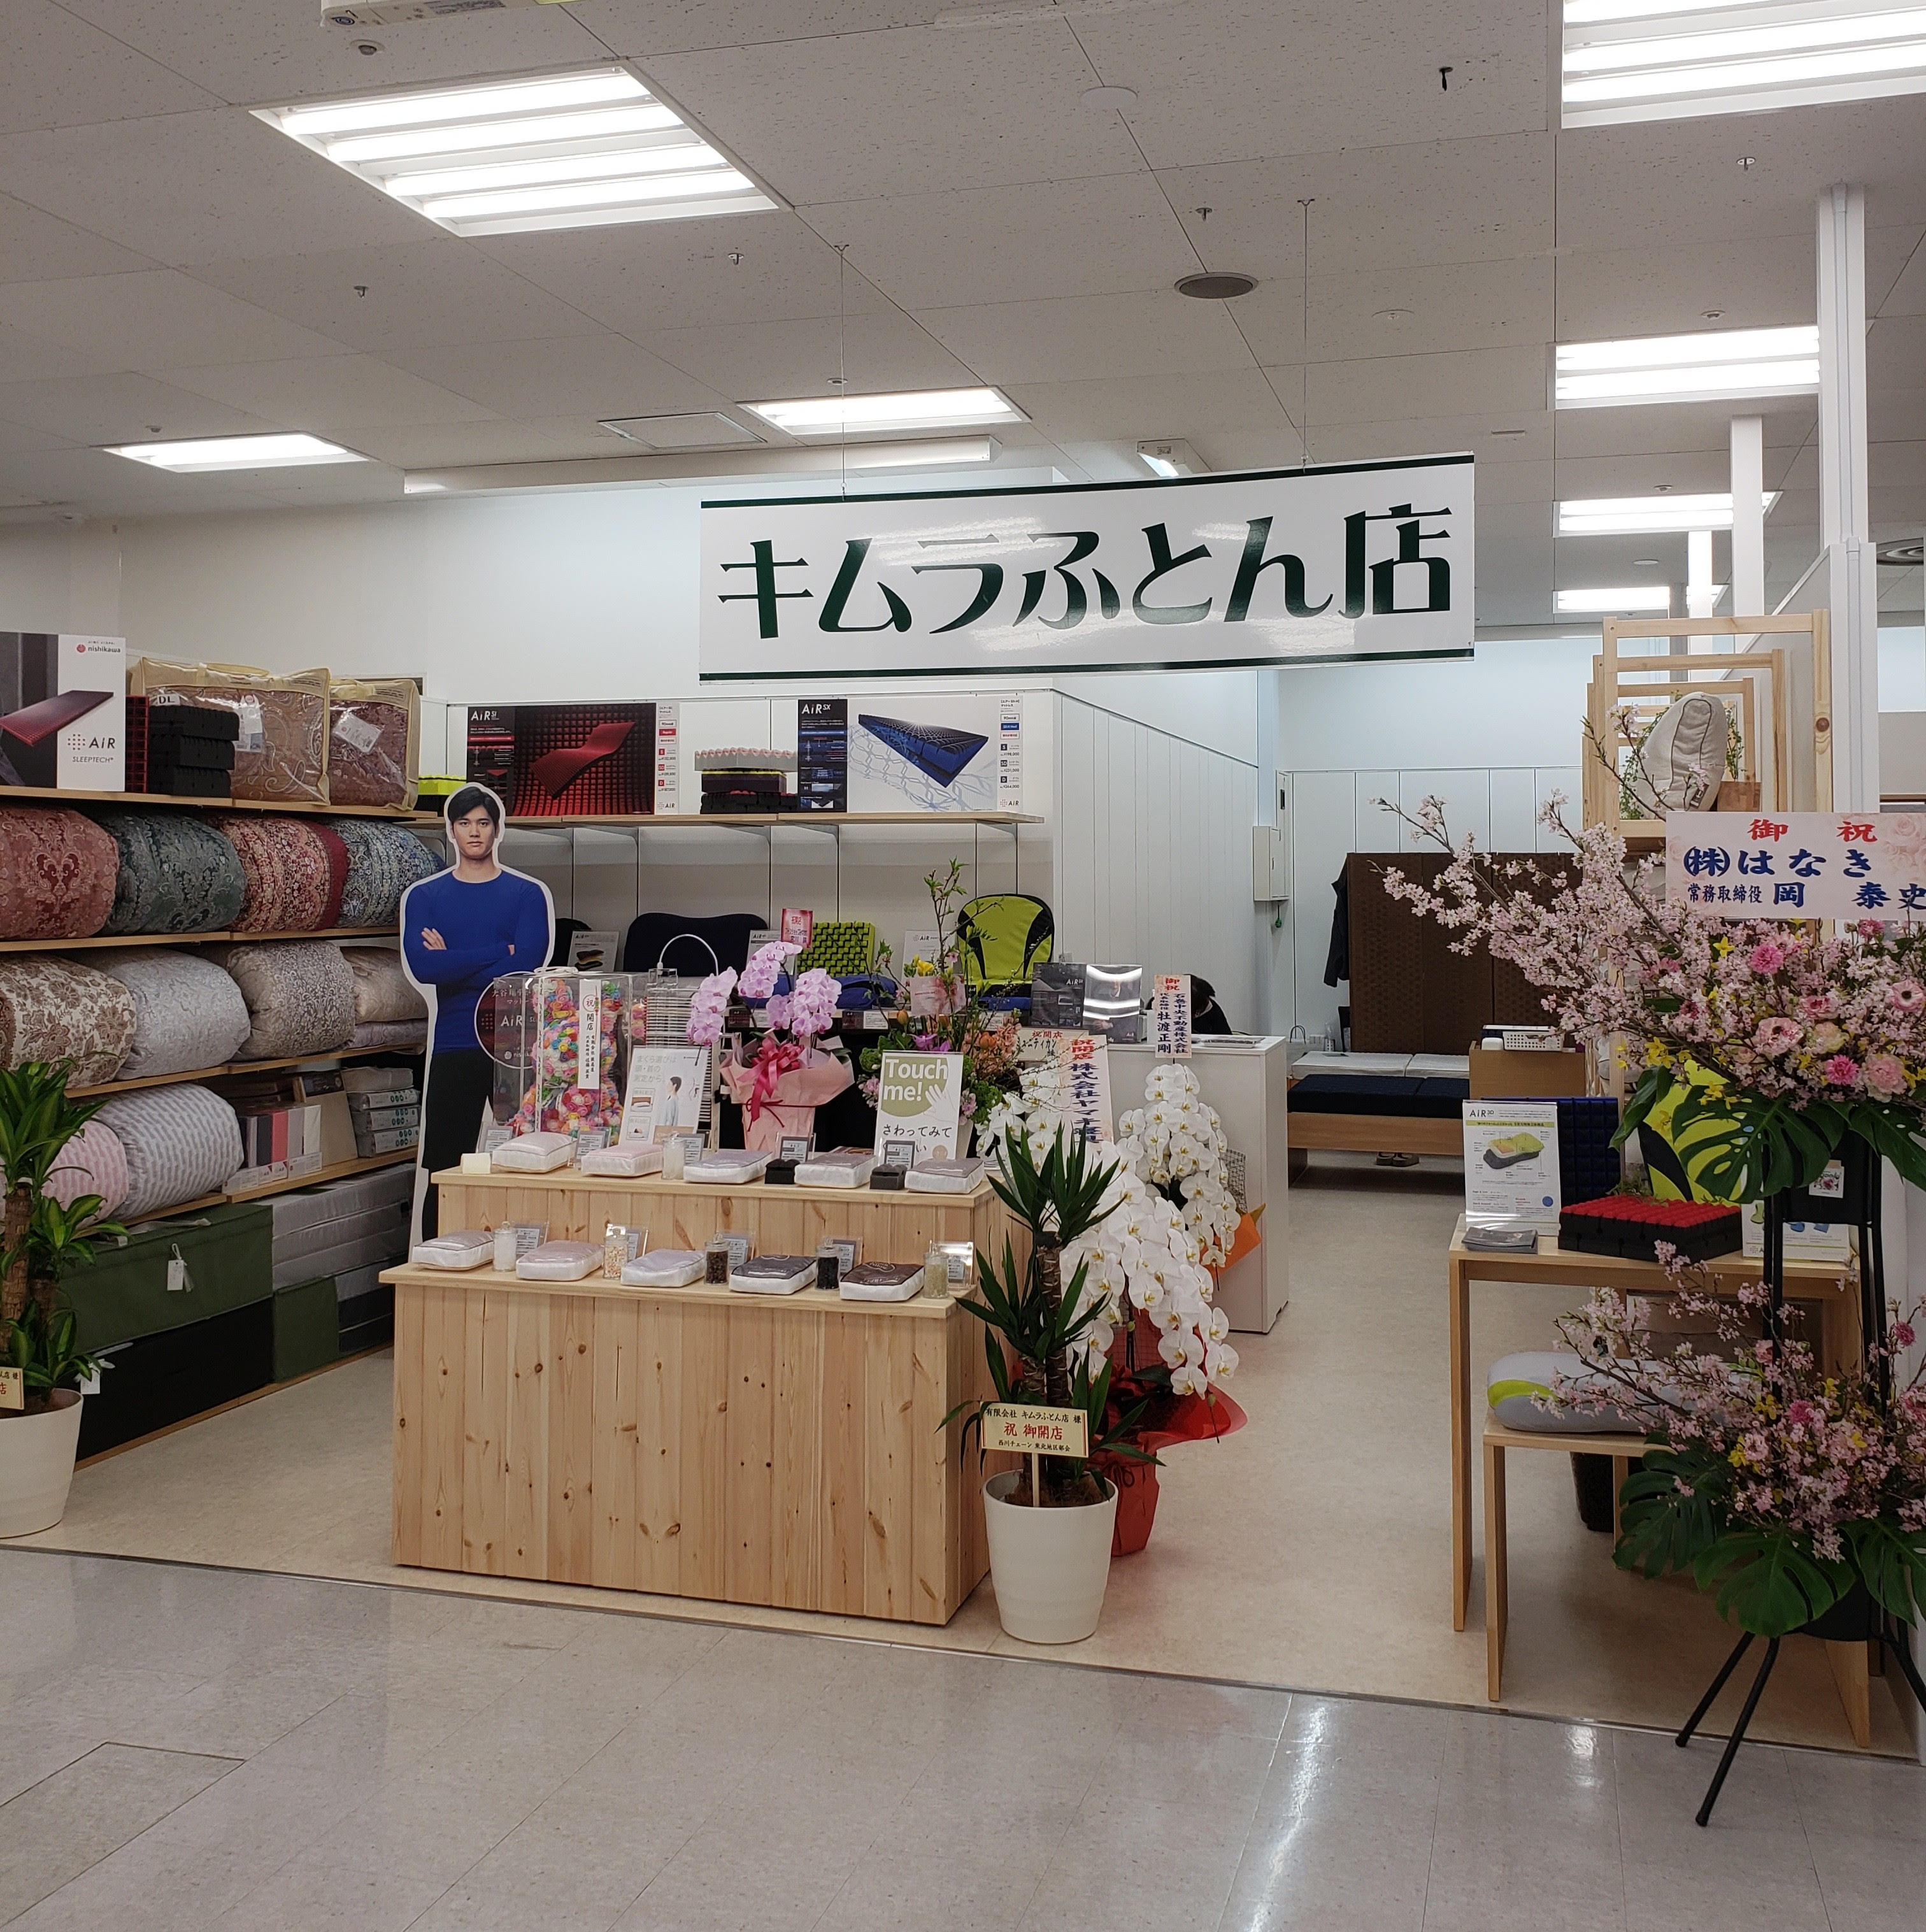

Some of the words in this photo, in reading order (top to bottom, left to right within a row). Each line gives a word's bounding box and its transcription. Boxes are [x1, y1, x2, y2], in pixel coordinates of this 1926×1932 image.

[717, 503, 1452, 638] キムラふとん店
[88, 645, 121, 653] nishikawa
[159, 696, 175, 704] DL
[1687, 882, 1762, 904] 常務取締役
[1773, 882, 1806, 908] 岡
[885, 1059, 948, 1080] Touch
[883, 1082, 923, 1101] me!
[883, 1124, 952, 1138] さわってみて
[986, 1408, 1017, 1418] 有限会社
[1022, 1410, 1069, 1423] キムラふとん店
[1073, 1414, 1082, 1424] 様
[1004, 1422, 1017, 1436] 祝
[1023, 1424, 1063, 1440] 御開店
[998, 1439, 1032, 1449] 西川チェーン
